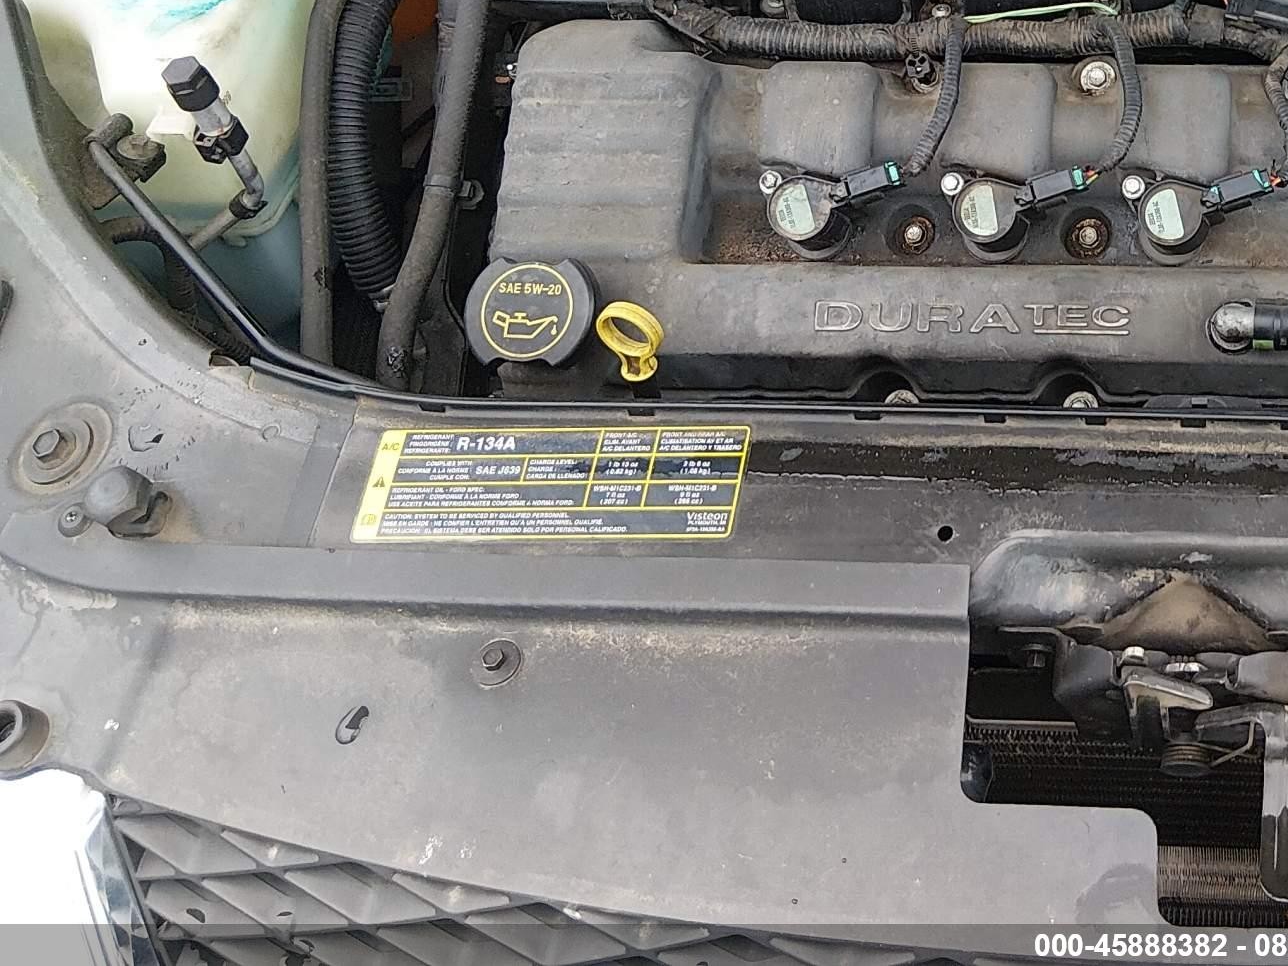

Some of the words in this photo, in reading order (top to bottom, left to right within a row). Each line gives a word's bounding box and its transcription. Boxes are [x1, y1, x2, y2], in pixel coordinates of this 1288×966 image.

[499, 283, 521, 294] SAE
[523, 283, 562, 295] 5W-20
[814, 300, 1130, 333] DURATEC
[382, 443, 400, 451] A/C
[456, 436, 516, 451] R-134A
[475, 465, 496, 475] SAE
[498, 465, 521, 475] J639
[687, 511, 728, 521] Visteon
